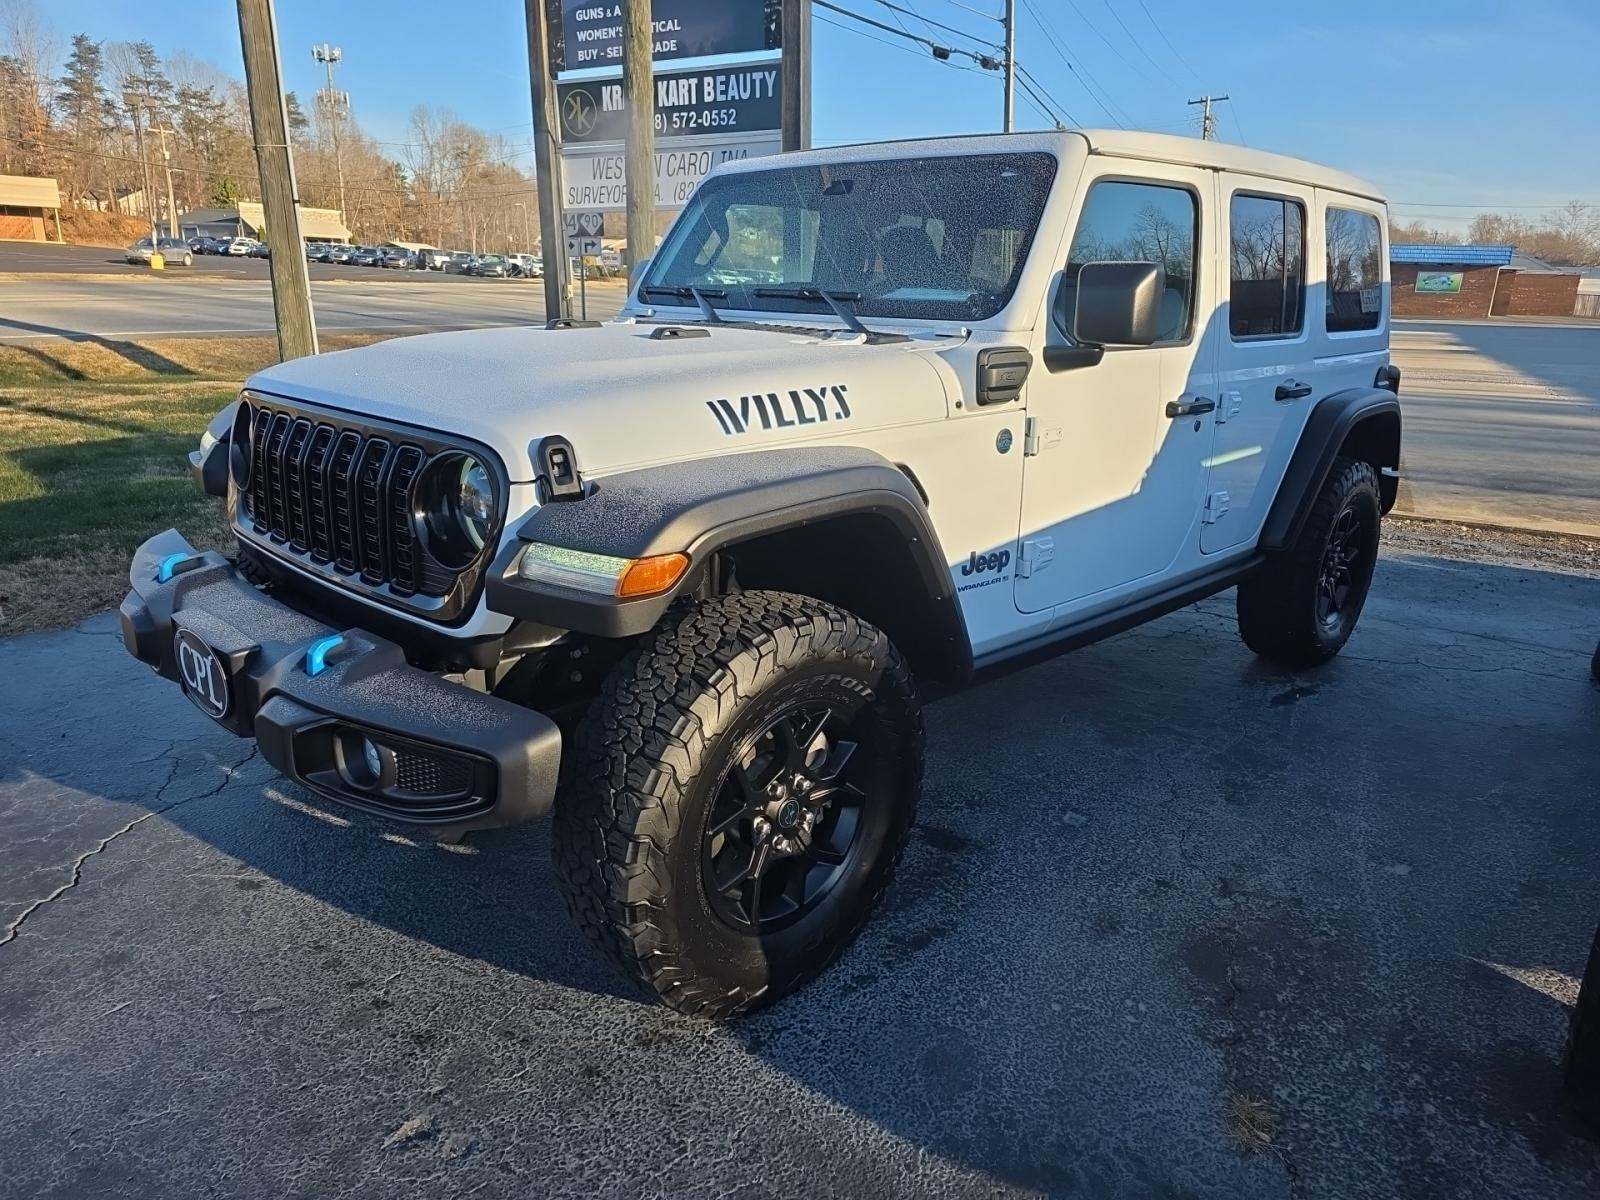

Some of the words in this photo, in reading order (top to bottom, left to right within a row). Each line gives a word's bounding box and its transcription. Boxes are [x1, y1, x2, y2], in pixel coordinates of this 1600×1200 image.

[575, 7, 604, 21] GUNS
[606, 8, 611, 18] &
[577, 48, 599, 61] BUY
[657, 77, 698, 107] KART
[703, 70, 777, 103] BEAUTY
[672, 108, 737, 129] 572-0552
[584, 214, 599, 229] 90
[705, 384, 852, 435] WILLYS
[961, 549, 1011, 577] Jeep
[957, 577, 1002, 593] WRANGLER
